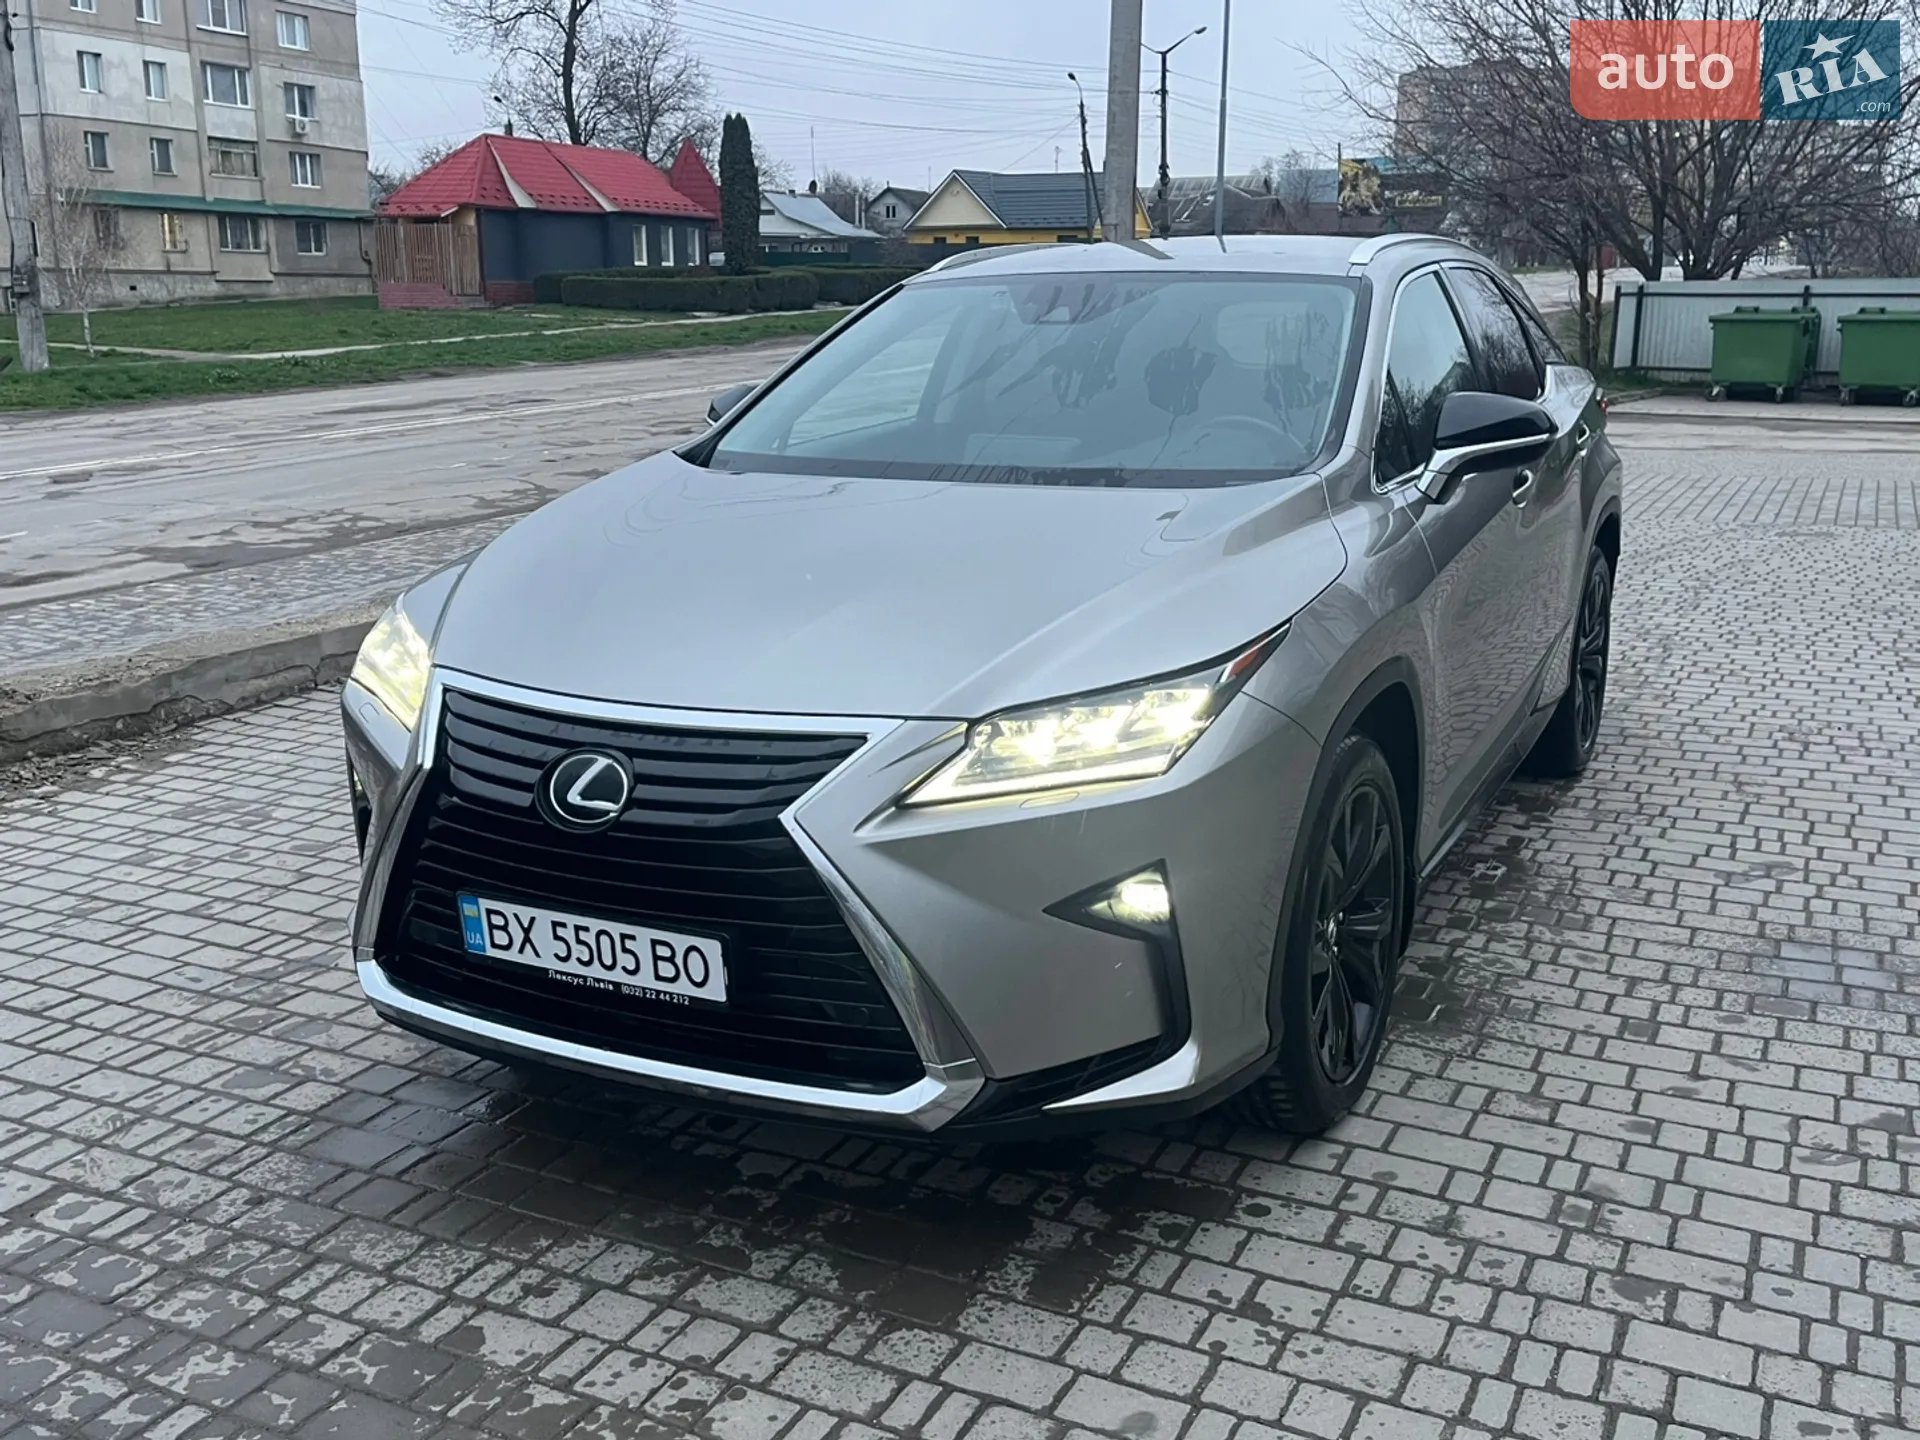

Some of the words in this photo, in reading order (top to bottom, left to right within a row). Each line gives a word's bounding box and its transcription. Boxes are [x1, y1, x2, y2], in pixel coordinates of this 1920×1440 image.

[466, 931, 484, 946] UA
[485, 907, 542, 959] BX
[550, 920, 641, 976] 5505
[650, 938, 710, 989] BO
[621, 984, 643, 998] (032)
[645, 990, 657, 1000] 22
[659, 992, 671, 1002] 44
[672, 995, 690, 1006] 212
